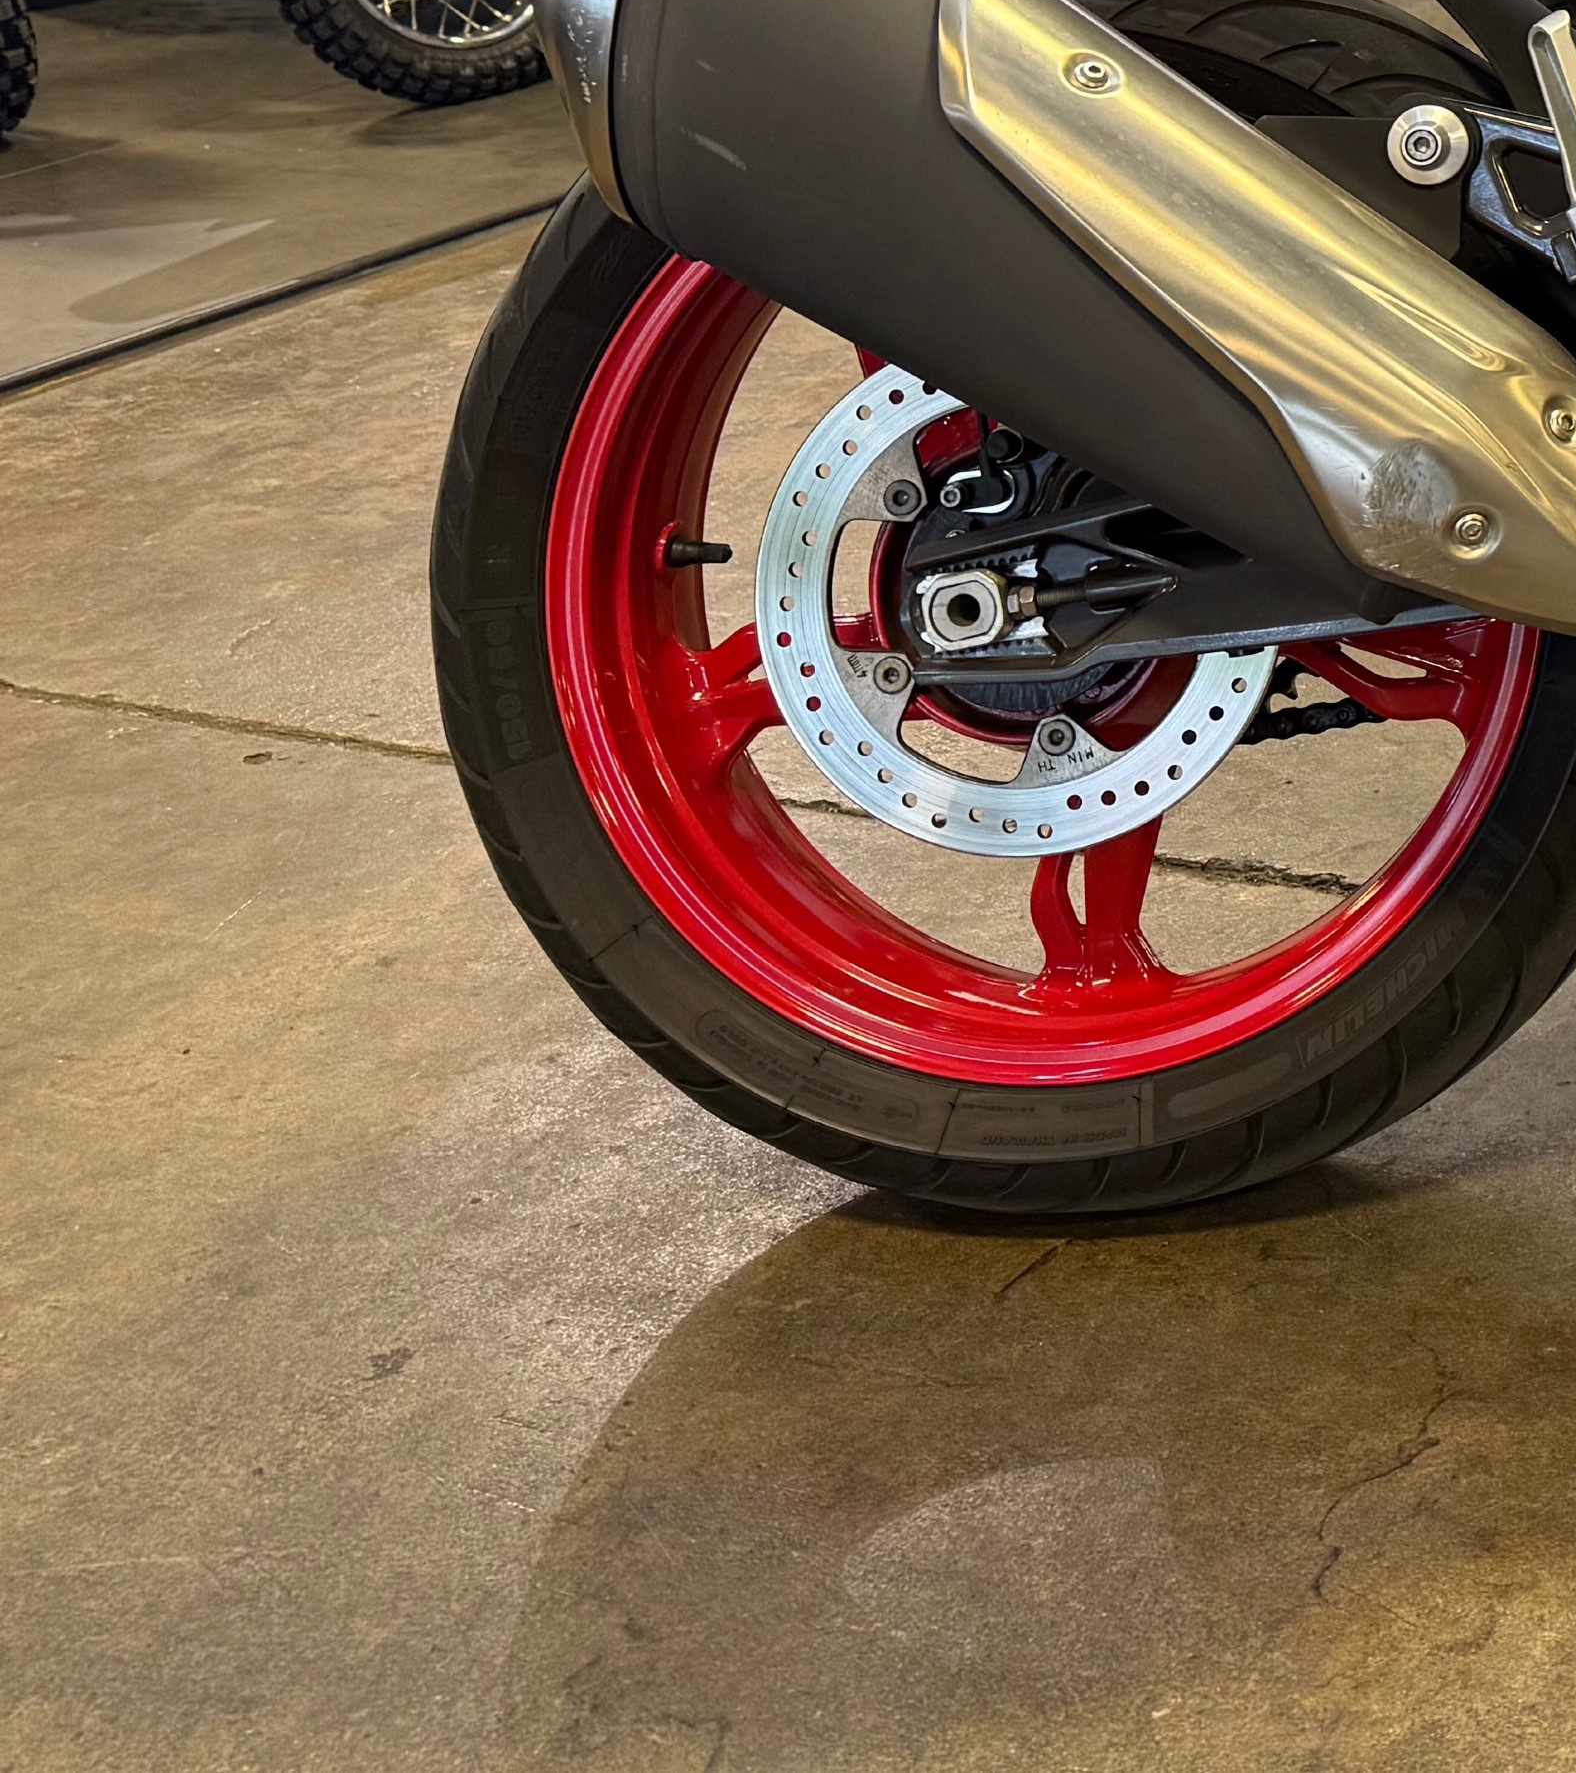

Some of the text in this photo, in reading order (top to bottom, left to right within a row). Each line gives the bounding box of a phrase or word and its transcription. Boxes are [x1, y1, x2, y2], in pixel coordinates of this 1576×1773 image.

[1037, 746, 1095, 774] MIN TH
[1303, 903, 1466, 1065] MICHELIN
